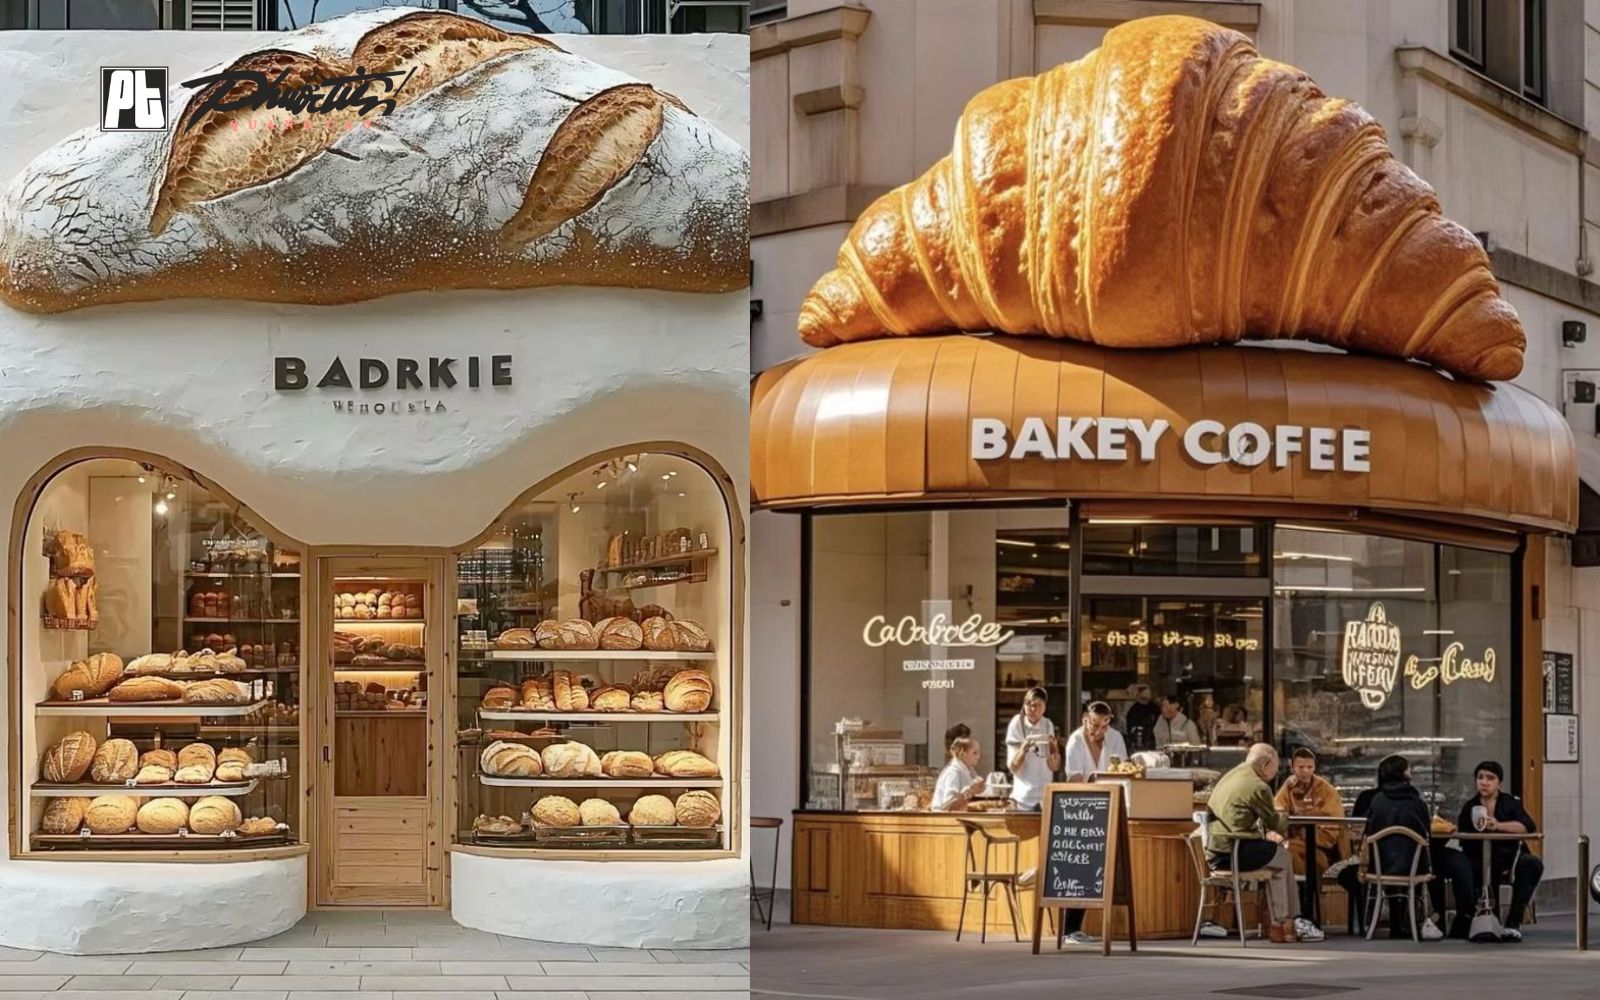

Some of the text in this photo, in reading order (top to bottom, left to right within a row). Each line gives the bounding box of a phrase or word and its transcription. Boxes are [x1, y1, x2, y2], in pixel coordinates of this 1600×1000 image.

[274, 355, 514, 391] BADRKIE
[971, 416, 1372, 473] BAKEY COFEE
